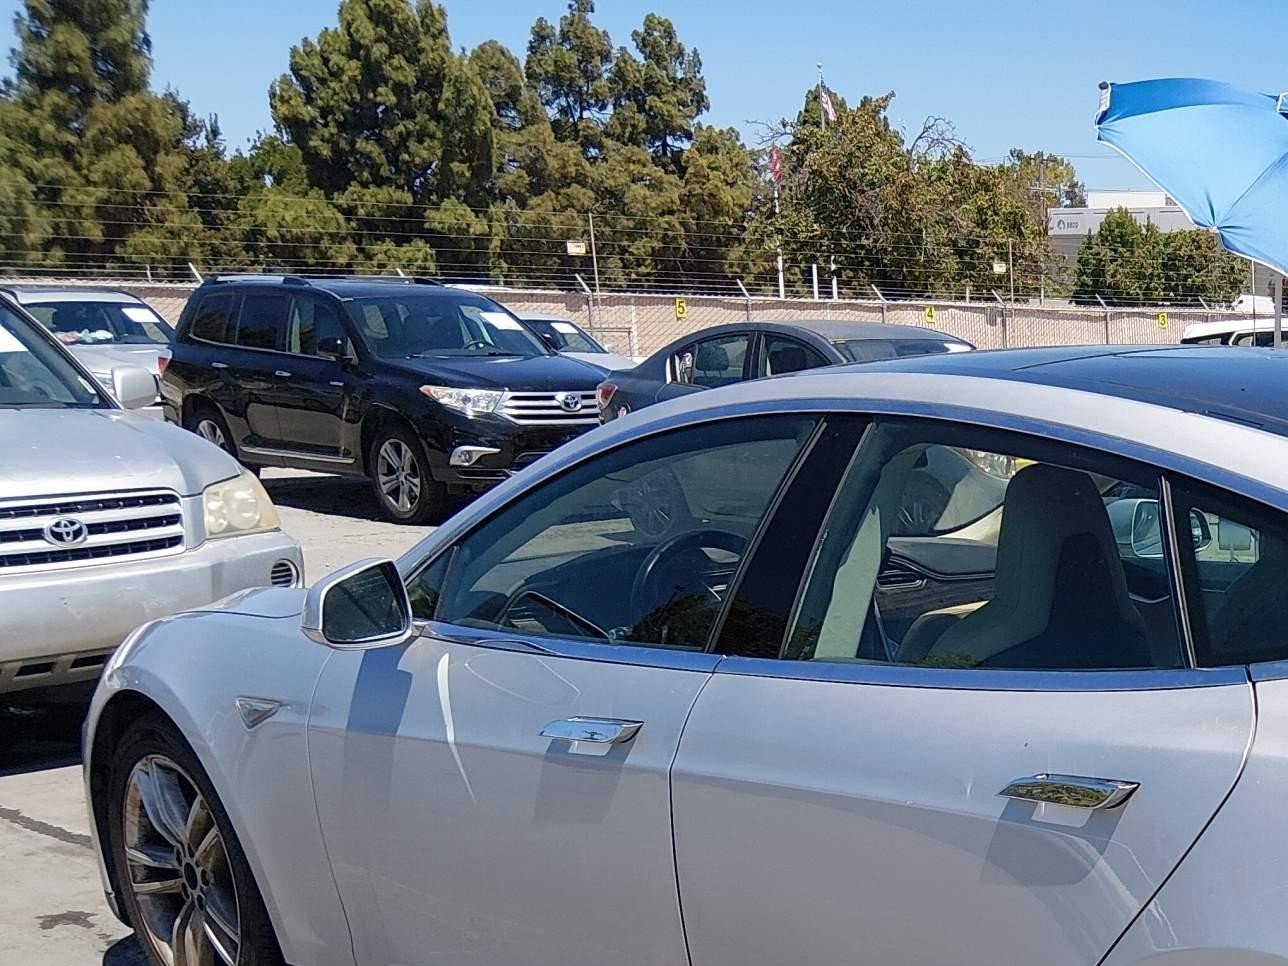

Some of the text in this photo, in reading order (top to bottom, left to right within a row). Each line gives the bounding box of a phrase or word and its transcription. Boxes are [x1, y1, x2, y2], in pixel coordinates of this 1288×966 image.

[677, 300, 685, 315] 5
[927, 306, 934, 320] 4
[1159, 314, 1166, 326] 3
